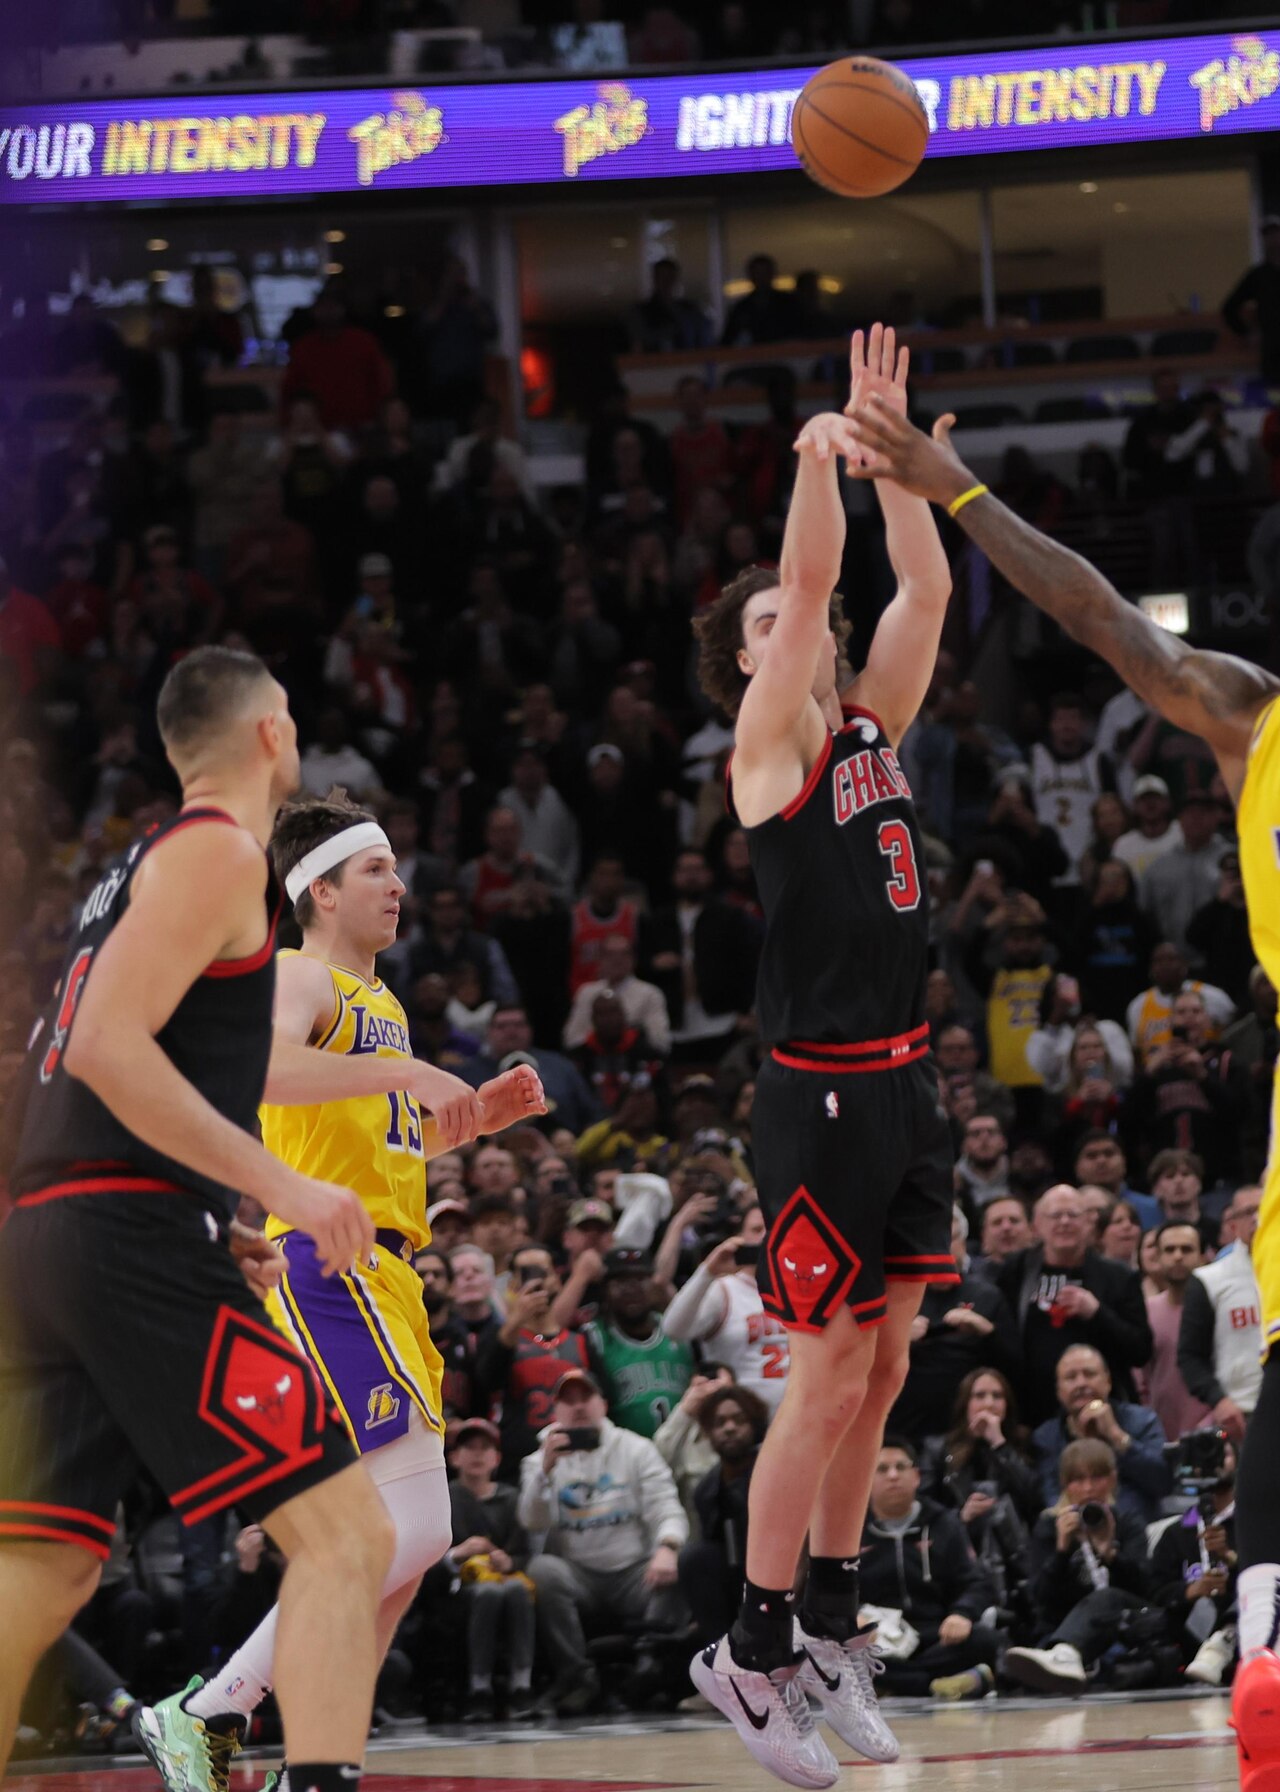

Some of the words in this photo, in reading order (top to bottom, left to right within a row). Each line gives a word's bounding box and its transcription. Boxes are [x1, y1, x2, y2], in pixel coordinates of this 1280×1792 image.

[947, 60, 1166, 131] INTENSITY
[101, 113, 327, 176] INTENSITY
[877, 818, 922, 912] 3
[344, 1004, 413, 1057] LAKER
[384, 1089, 425, 1157] 15
